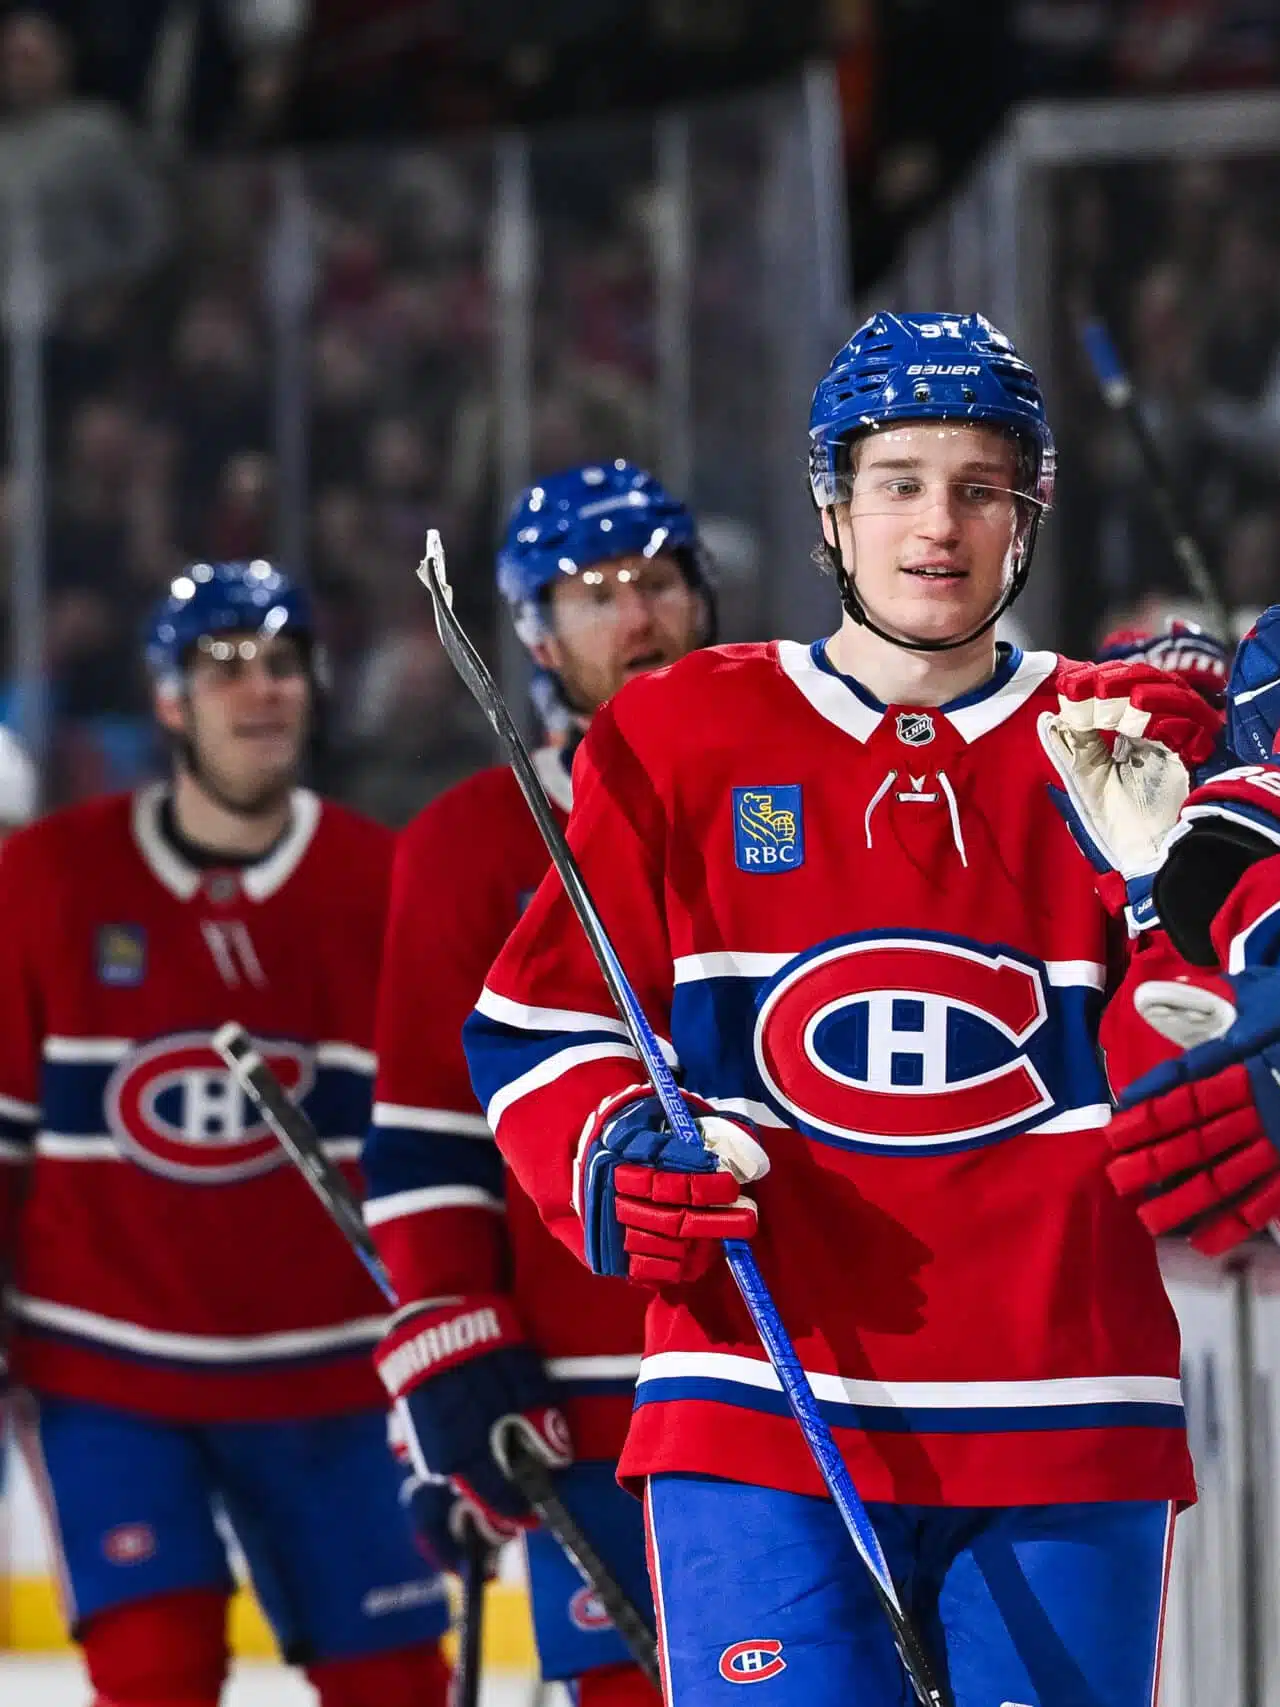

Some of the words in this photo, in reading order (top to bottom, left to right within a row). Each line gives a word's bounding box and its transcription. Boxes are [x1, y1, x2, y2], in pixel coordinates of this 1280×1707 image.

[906, 364, 981, 376] BAUER
[905, 720, 927, 739] LNH
[744, 845, 795, 865] RBC
[378, 1308, 502, 1395] WARRIOR
